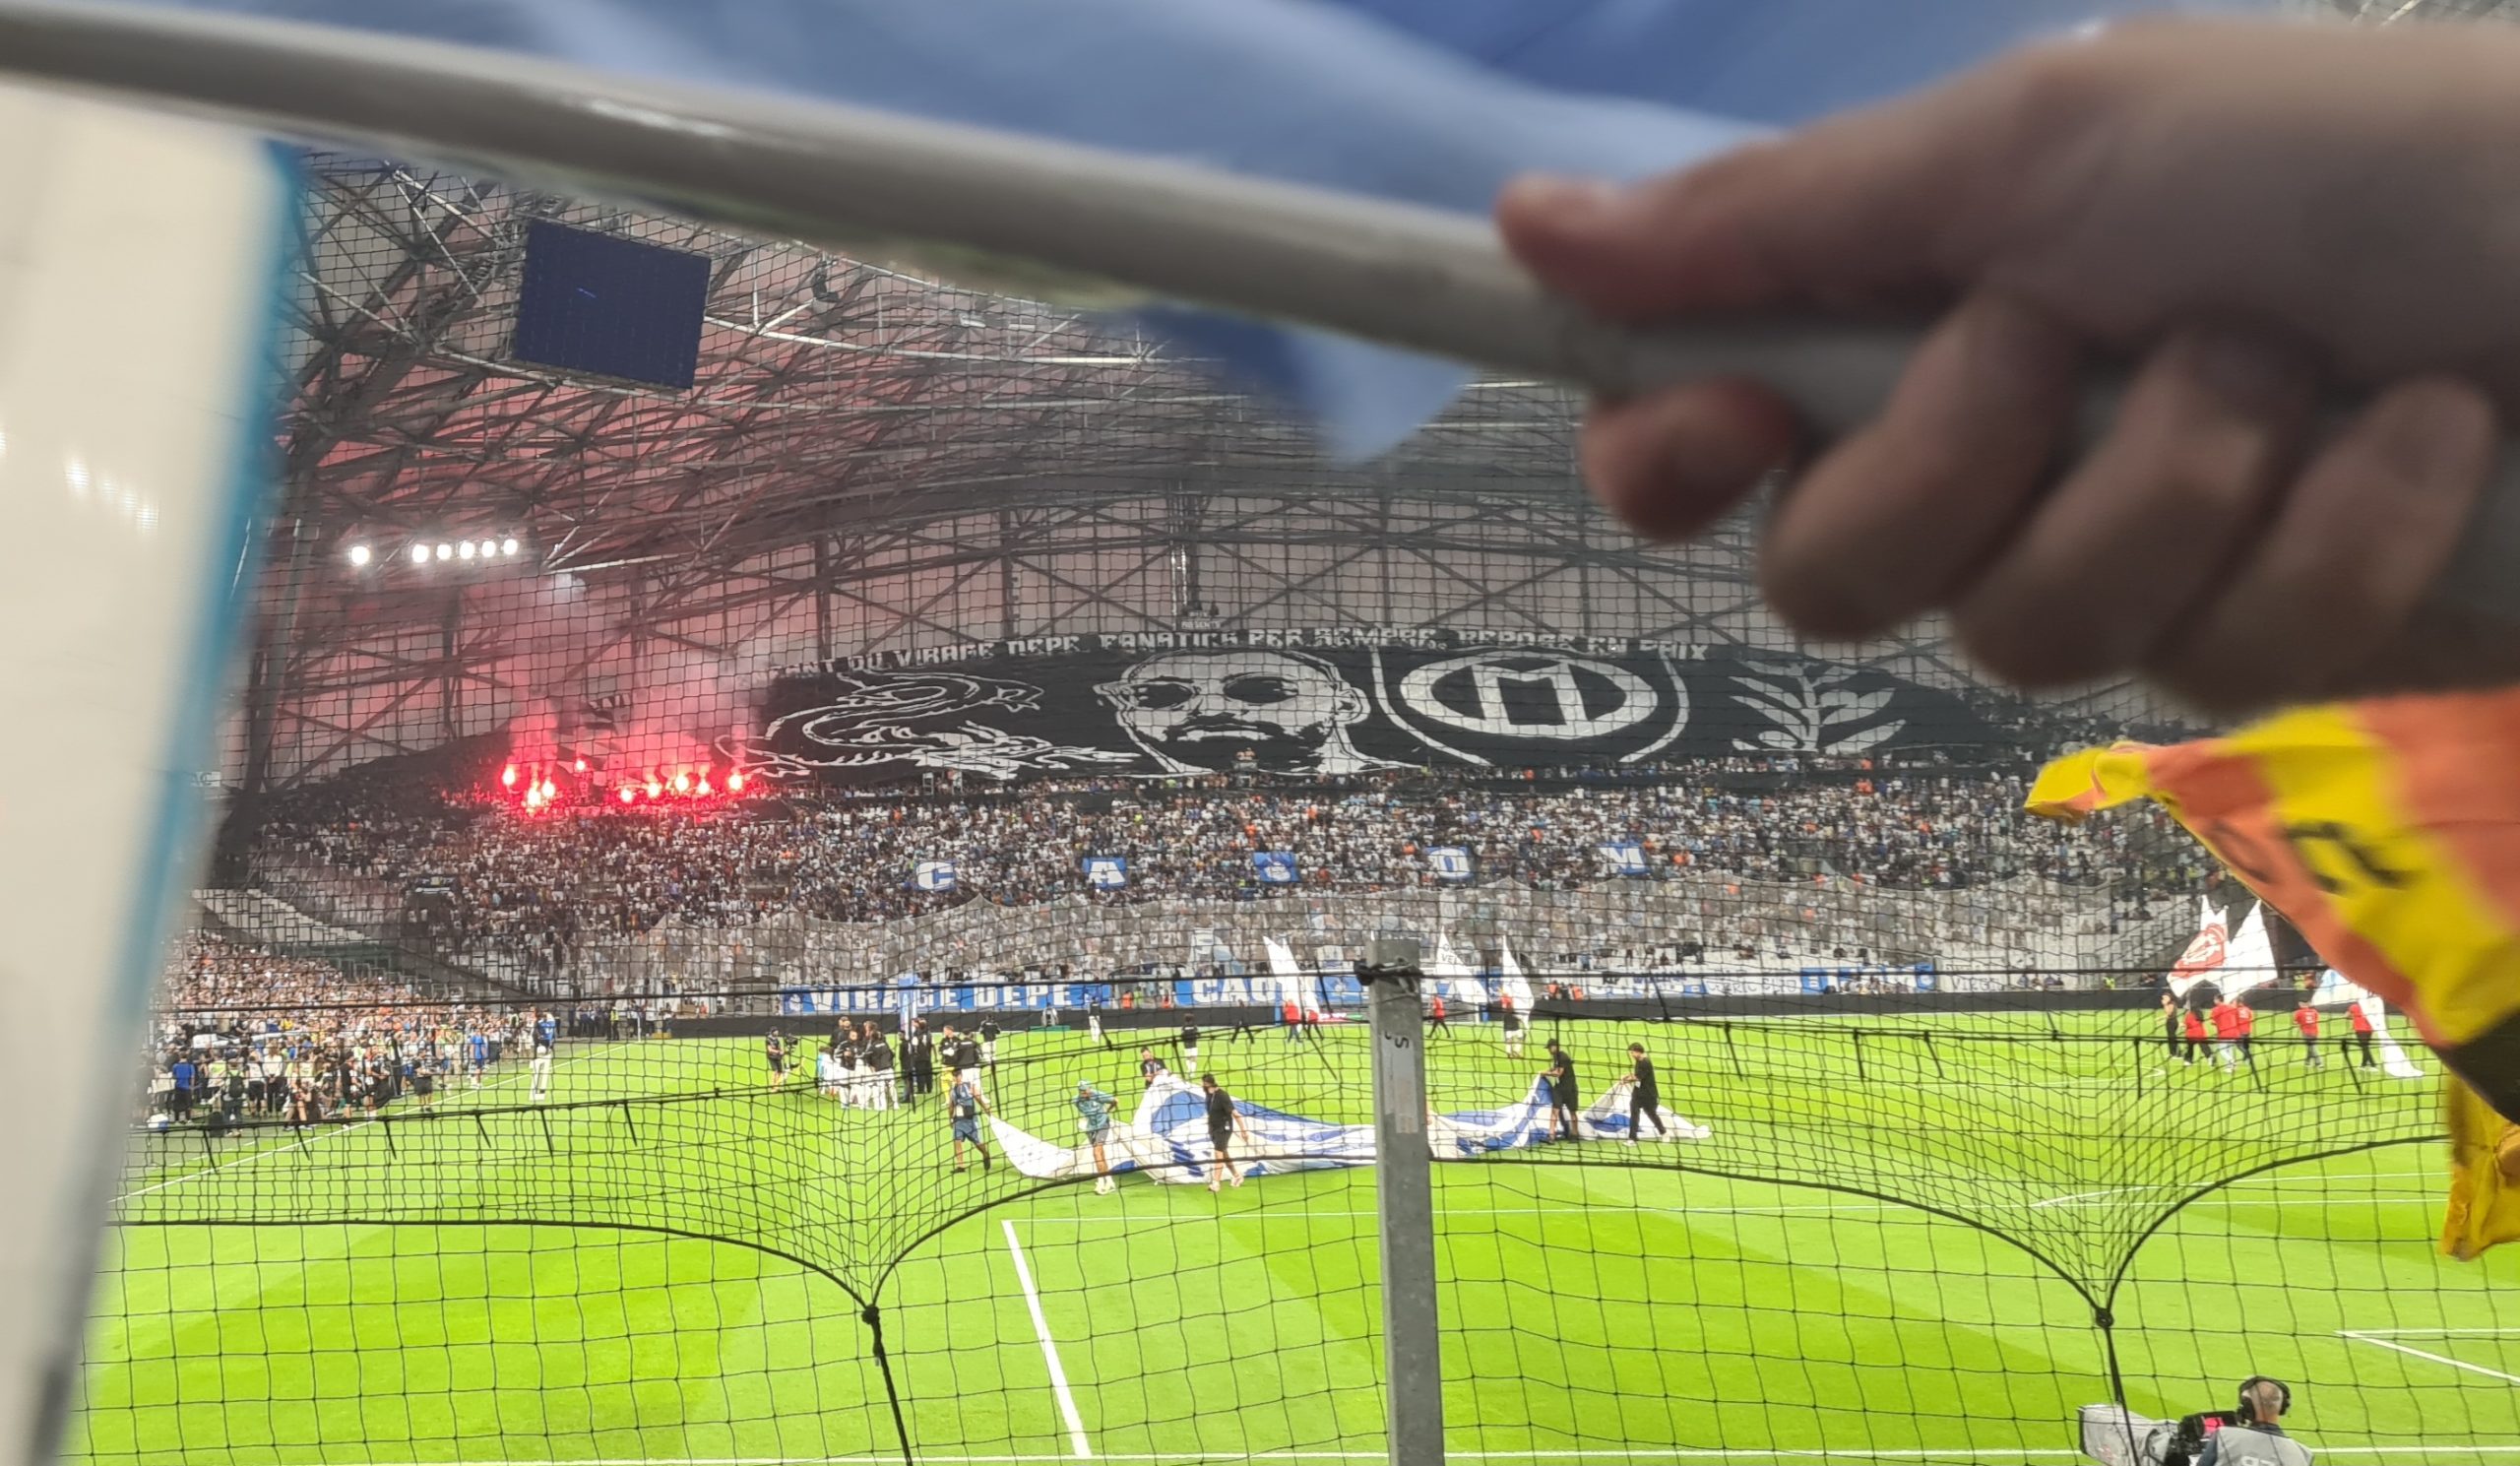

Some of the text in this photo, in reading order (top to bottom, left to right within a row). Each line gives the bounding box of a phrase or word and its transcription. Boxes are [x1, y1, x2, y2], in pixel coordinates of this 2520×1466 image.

[848, 654, 883, 671] DU
[894, 642, 994, 668] VIRAGE
[810, 983, 1072, 1011] VIRAGE DEPE
